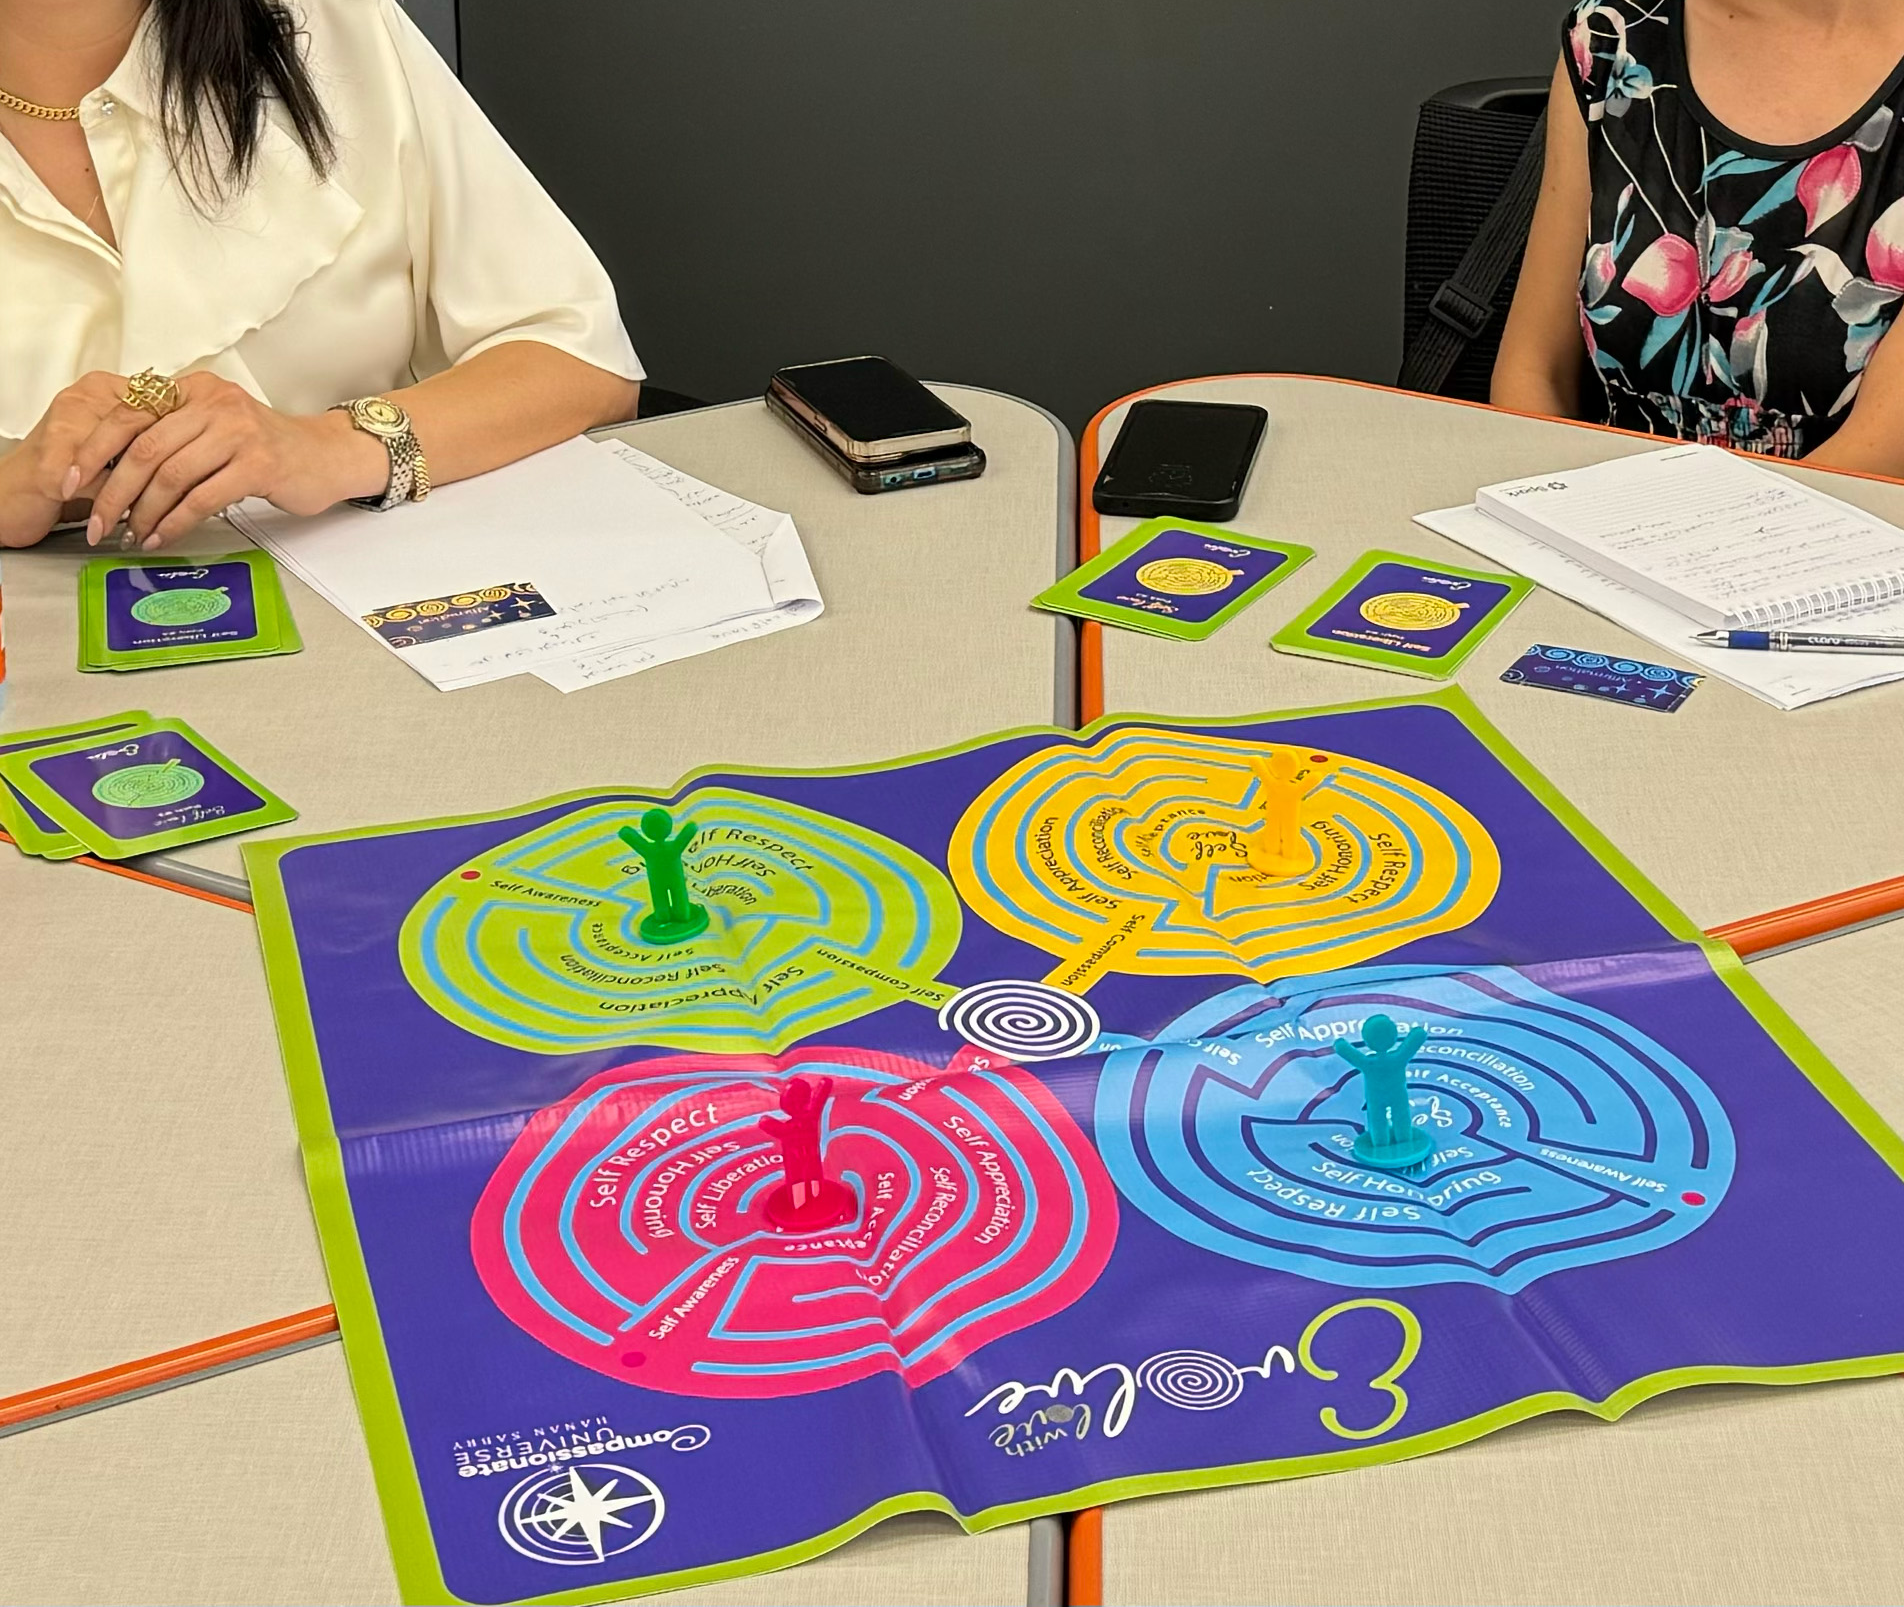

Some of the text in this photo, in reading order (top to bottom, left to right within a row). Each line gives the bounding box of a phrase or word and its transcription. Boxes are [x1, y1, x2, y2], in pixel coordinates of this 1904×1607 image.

[726, 828, 814, 871] Respect
[732, 858, 777, 877] Self
[1034, 817, 1123, 910] Self Appreciation
[1310, 821, 1352, 874] Honoring
[1342, 833, 1407, 904] Self Respect
[490, 880, 602, 908] Self Awareness
[1108, 861, 1139, 882] Self
[560, 954, 726, 988] Self Reconciliation
[656, 947, 694, 962] Self
[1060, 913, 1146, 987] Self Compassion
[598, 966, 805, 1015] Self Appreciation
[816, 948, 946, 1002] Self Compassion
[1203, 1041, 1243, 1066] Self
[1255, 1022, 1293, 1048] Self
[1437, 1074, 1512, 1129] Acceptance
[590, 1103, 719, 1209] Self Respect
[929, 1166, 952, 1193] Self
[1311, 1161, 1360, 1188] Self
[1430, 1146, 1474, 1167] Self
[1539, 1148, 1669, 1194] Self Awareness
[643, 1140, 742, 1241] Self Honoring
[696, 1153, 785, 1230] Self Liberatio
[943, 1114, 1017, 1246] Self Appreciation
[1246, 1168, 1421, 1222] Self Respect
[784, 1171, 895, 1252] Self Acceptance
[648, 1255, 740, 1341] Self Awareness
[452, 1416, 608, 1450] HANAN SABRY
[453, 1427, 616, 1466] UNIVERSE
[458, 1424, 712, 1478] Compassionate
[1004, 1428, 1068, 1457] with
